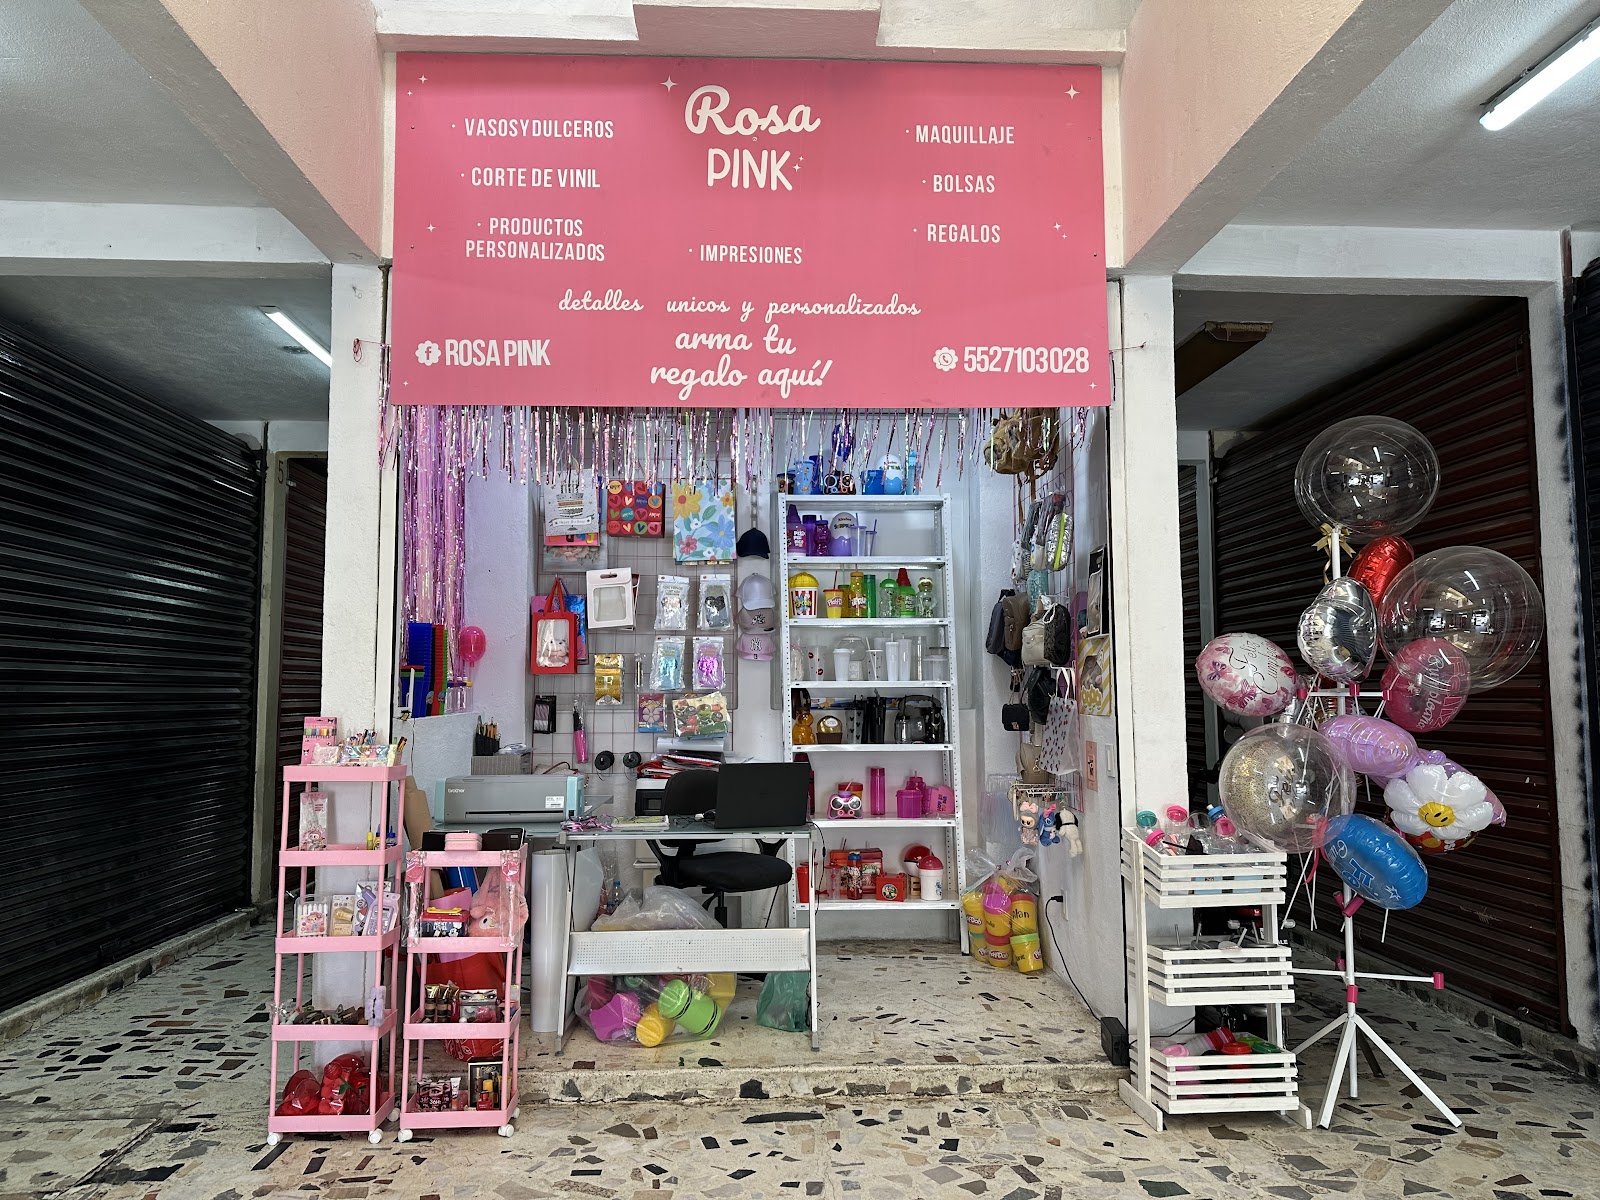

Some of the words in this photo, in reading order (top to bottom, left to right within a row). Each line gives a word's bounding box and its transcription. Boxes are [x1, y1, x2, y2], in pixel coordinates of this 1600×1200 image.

[684, 85, 821, 136] Rosa
[915, 124, 1016, 145] MAQUILLAJE
[471, 166, 527, 188] CORTE
[531, 167, 553, 188] DE
[557, 168, 601, 188] VINIL
[707, 147, 793, 192] PINK
[932, 174, 996, 194] BOLSAS
[489, 217, 584, 237] PRODUCTOS
[927, 223, 1002, 244] REGALOS
[465, 239, 606, 262] PERSONALIZADOS
[699, 244, 803, 265] IMPRESIONES
[558, 288, 645, 312] detalles
[666, 296, 731, 313] unicos
[740, 300, 755, 323] y
[764, 292, 922, 324] personalizados
[675, 332, 753, 351] arma
[762, 323, 797, 355] tu
[445, 338, 501, 367] ROSA
[503, 339, 551, 367] PINK
[963, 345, 1091, 374] 5527103028
[650, 353, 748, 401] regalo
[757, 359, 834, 400] aquí!
[601, 675, 614, 690] F
